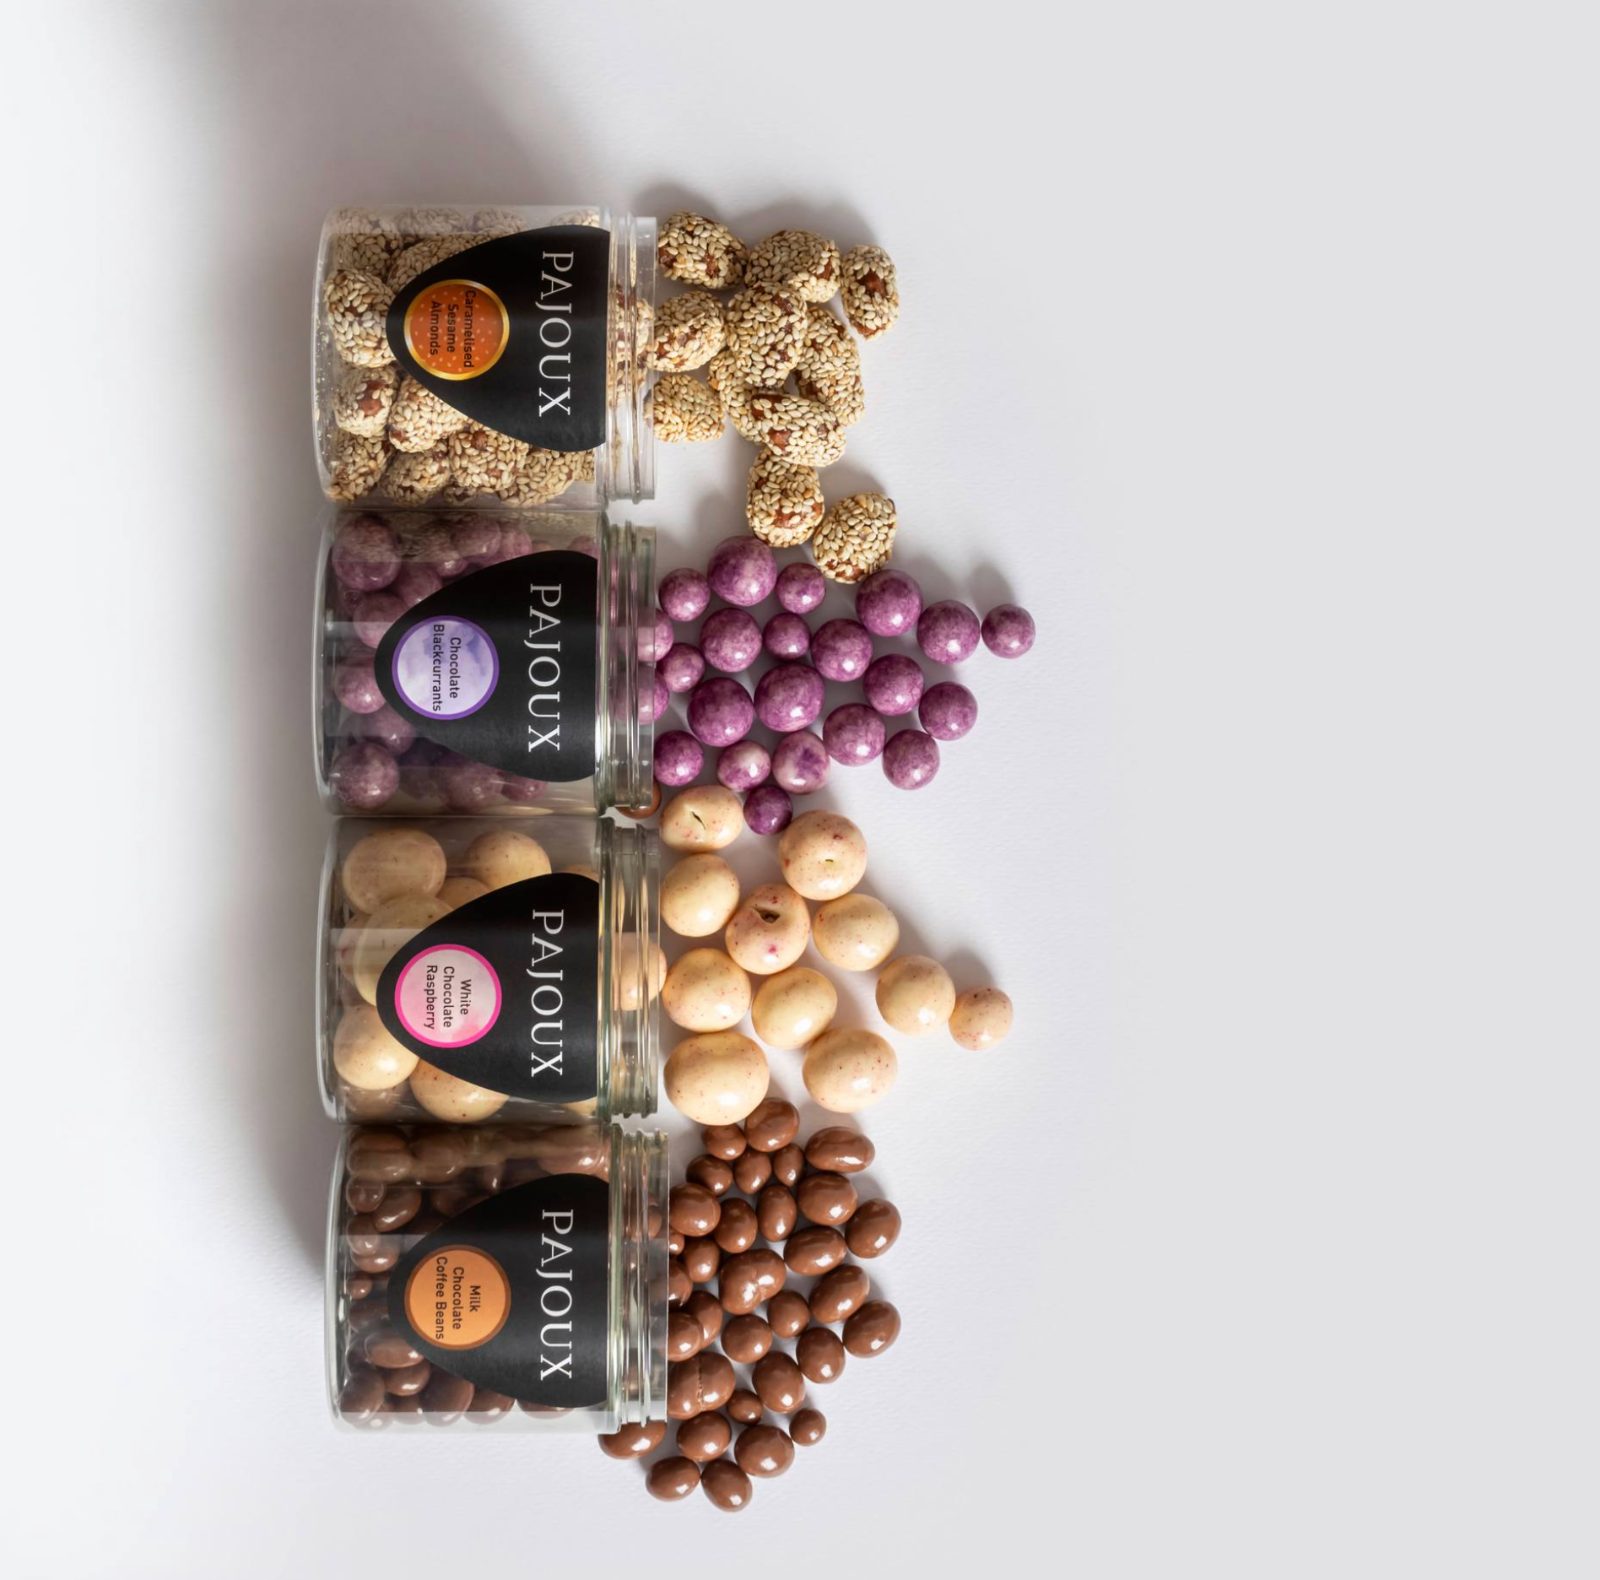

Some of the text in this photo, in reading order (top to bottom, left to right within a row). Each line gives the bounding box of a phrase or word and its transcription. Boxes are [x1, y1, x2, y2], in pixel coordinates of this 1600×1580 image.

[430, 300, 442, 356] Almonds
[447, 303, 459, 353] Sesame
[464, 290, 476, 369] Caramelised
[535, 250, 574, 417] PAJOUX
[432, 623, 445, 712] Blackcurrants
[449, 636, 462, 699] Chocolate
[523, 583, 562, 752] PAJOUX
[424, 964, 438, 1030] Raspberry
[443, 966, 456, 1028] Chocolate
[460, 978, 472, 1016] White
[526, 909, 565, 1078] PAJOUX
[435, 1256, 447, 1340] Coffee Beans
[452, 1266, 465, 1330] Chocolate
[469, 1284, 481, 1312] Milk
[536, 1209, 574, 1381] PAJOUX
